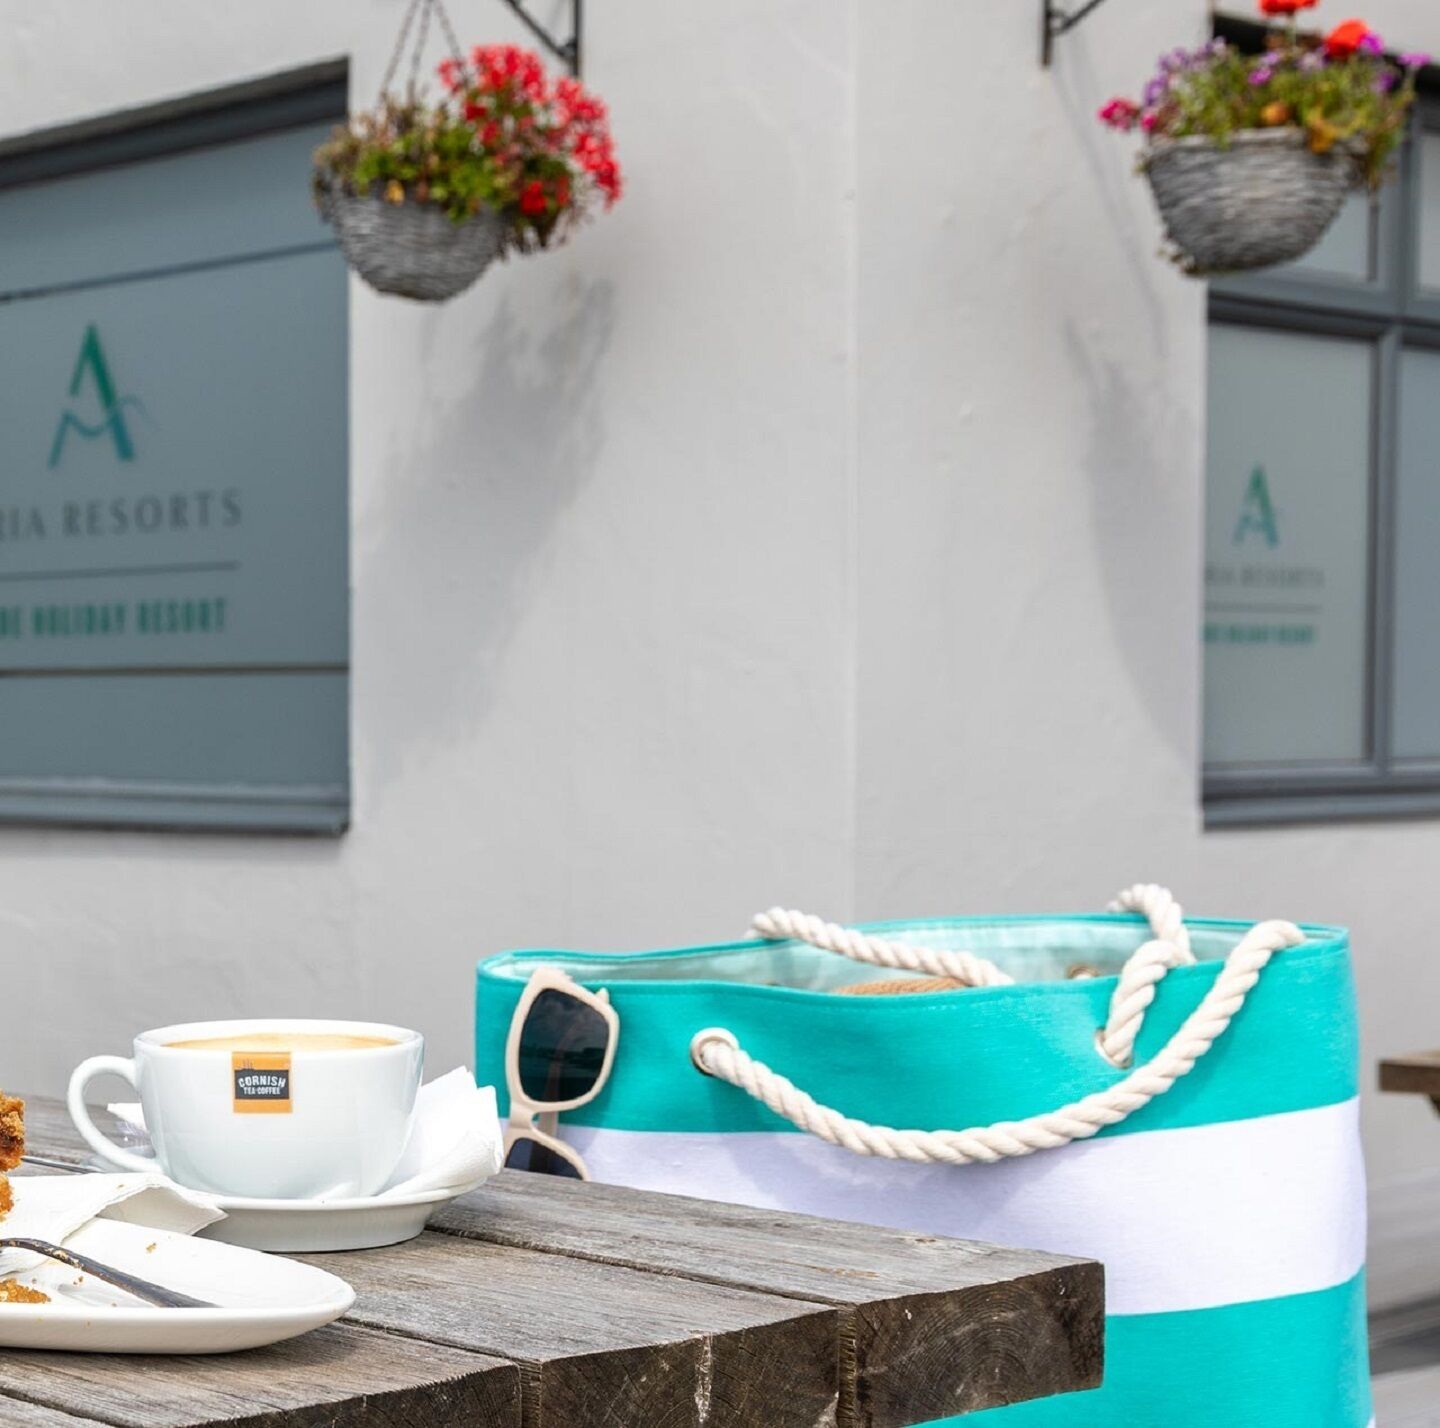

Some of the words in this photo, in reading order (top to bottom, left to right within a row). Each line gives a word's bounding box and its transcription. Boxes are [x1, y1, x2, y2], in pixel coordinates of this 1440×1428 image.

[62, 487, 242, 538] RESORTS
[33, 602, 126, 637] HOLIDAY
[137, 597, 227, 634] RESORT
[238, 1075, 286, 1088] CORNISH
